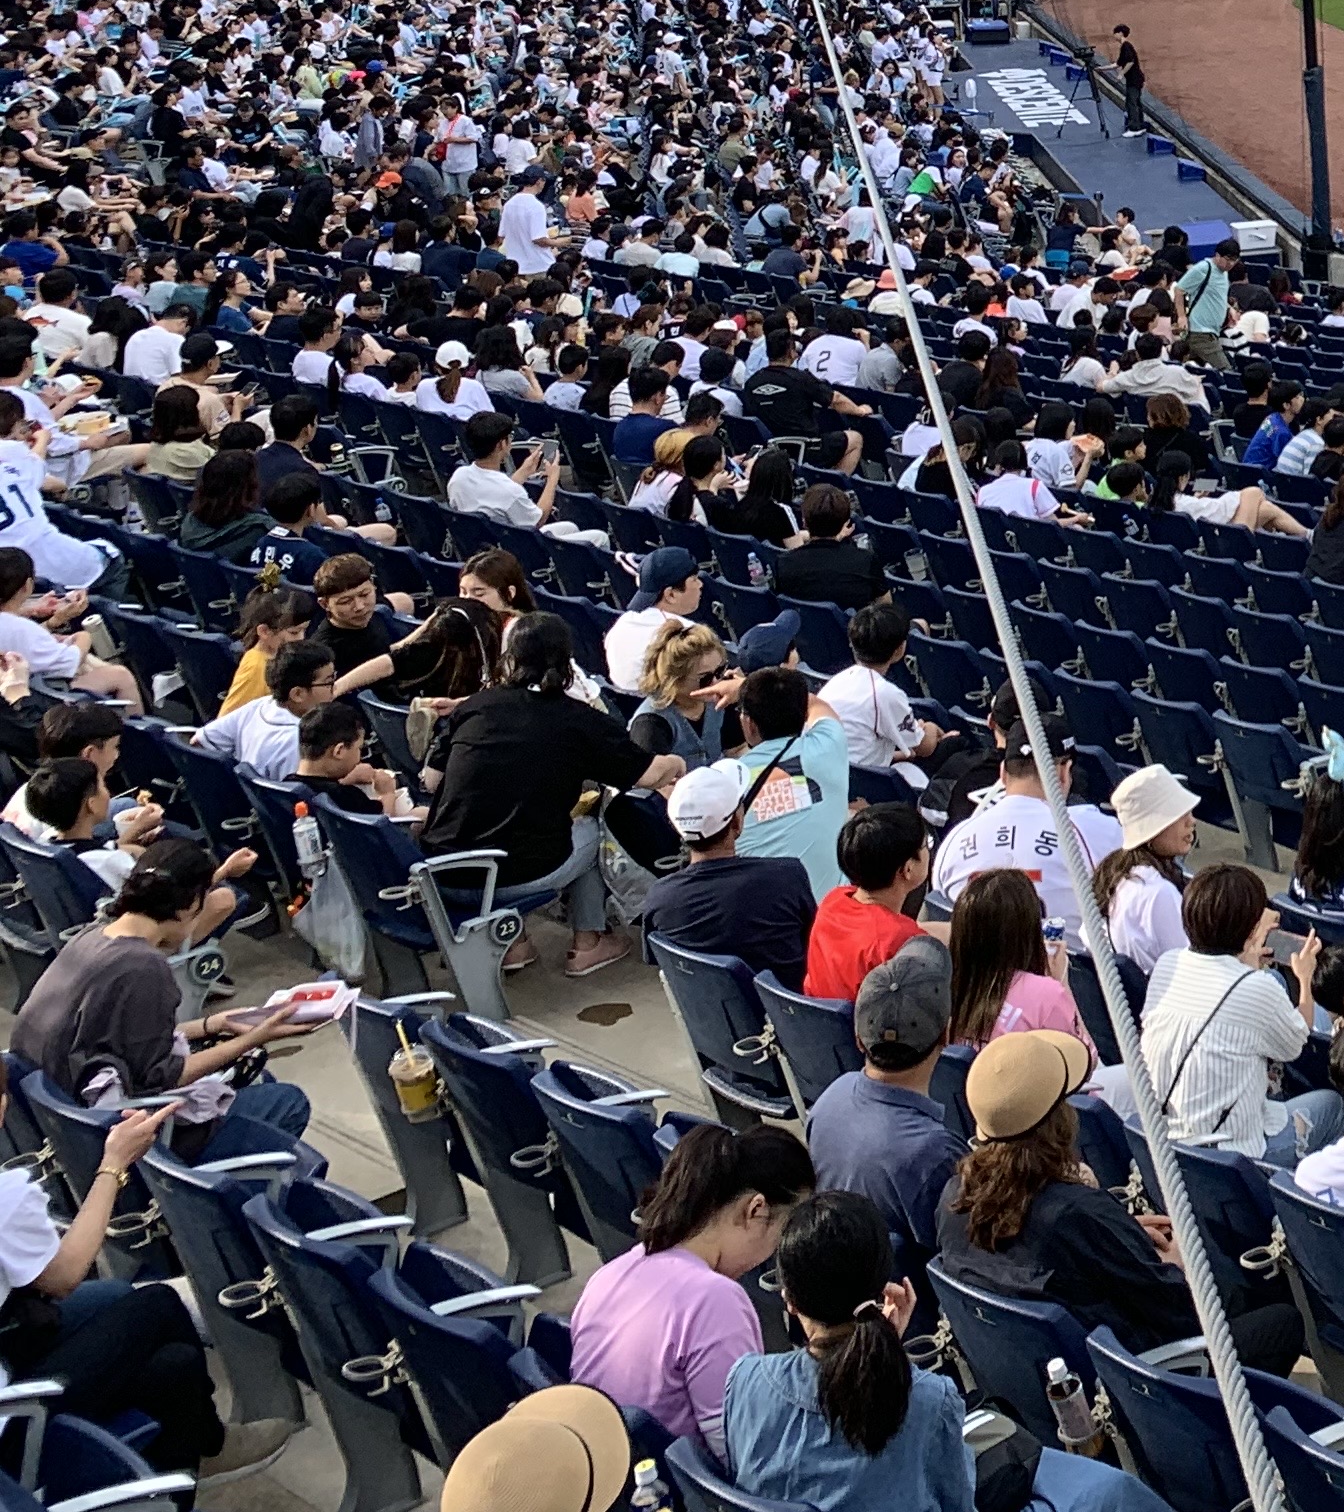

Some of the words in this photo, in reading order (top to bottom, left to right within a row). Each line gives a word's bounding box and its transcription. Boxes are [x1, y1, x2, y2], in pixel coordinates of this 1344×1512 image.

[986, 76, 1092, 129] DESCENTE
[816, 350, 831, 373] 2
[757, 800, 796, 822] FACE
[958, 824, 1059, 861] 권희동
[499, 921, 517, 938] 23
[200, 957, 220, 974] 24
